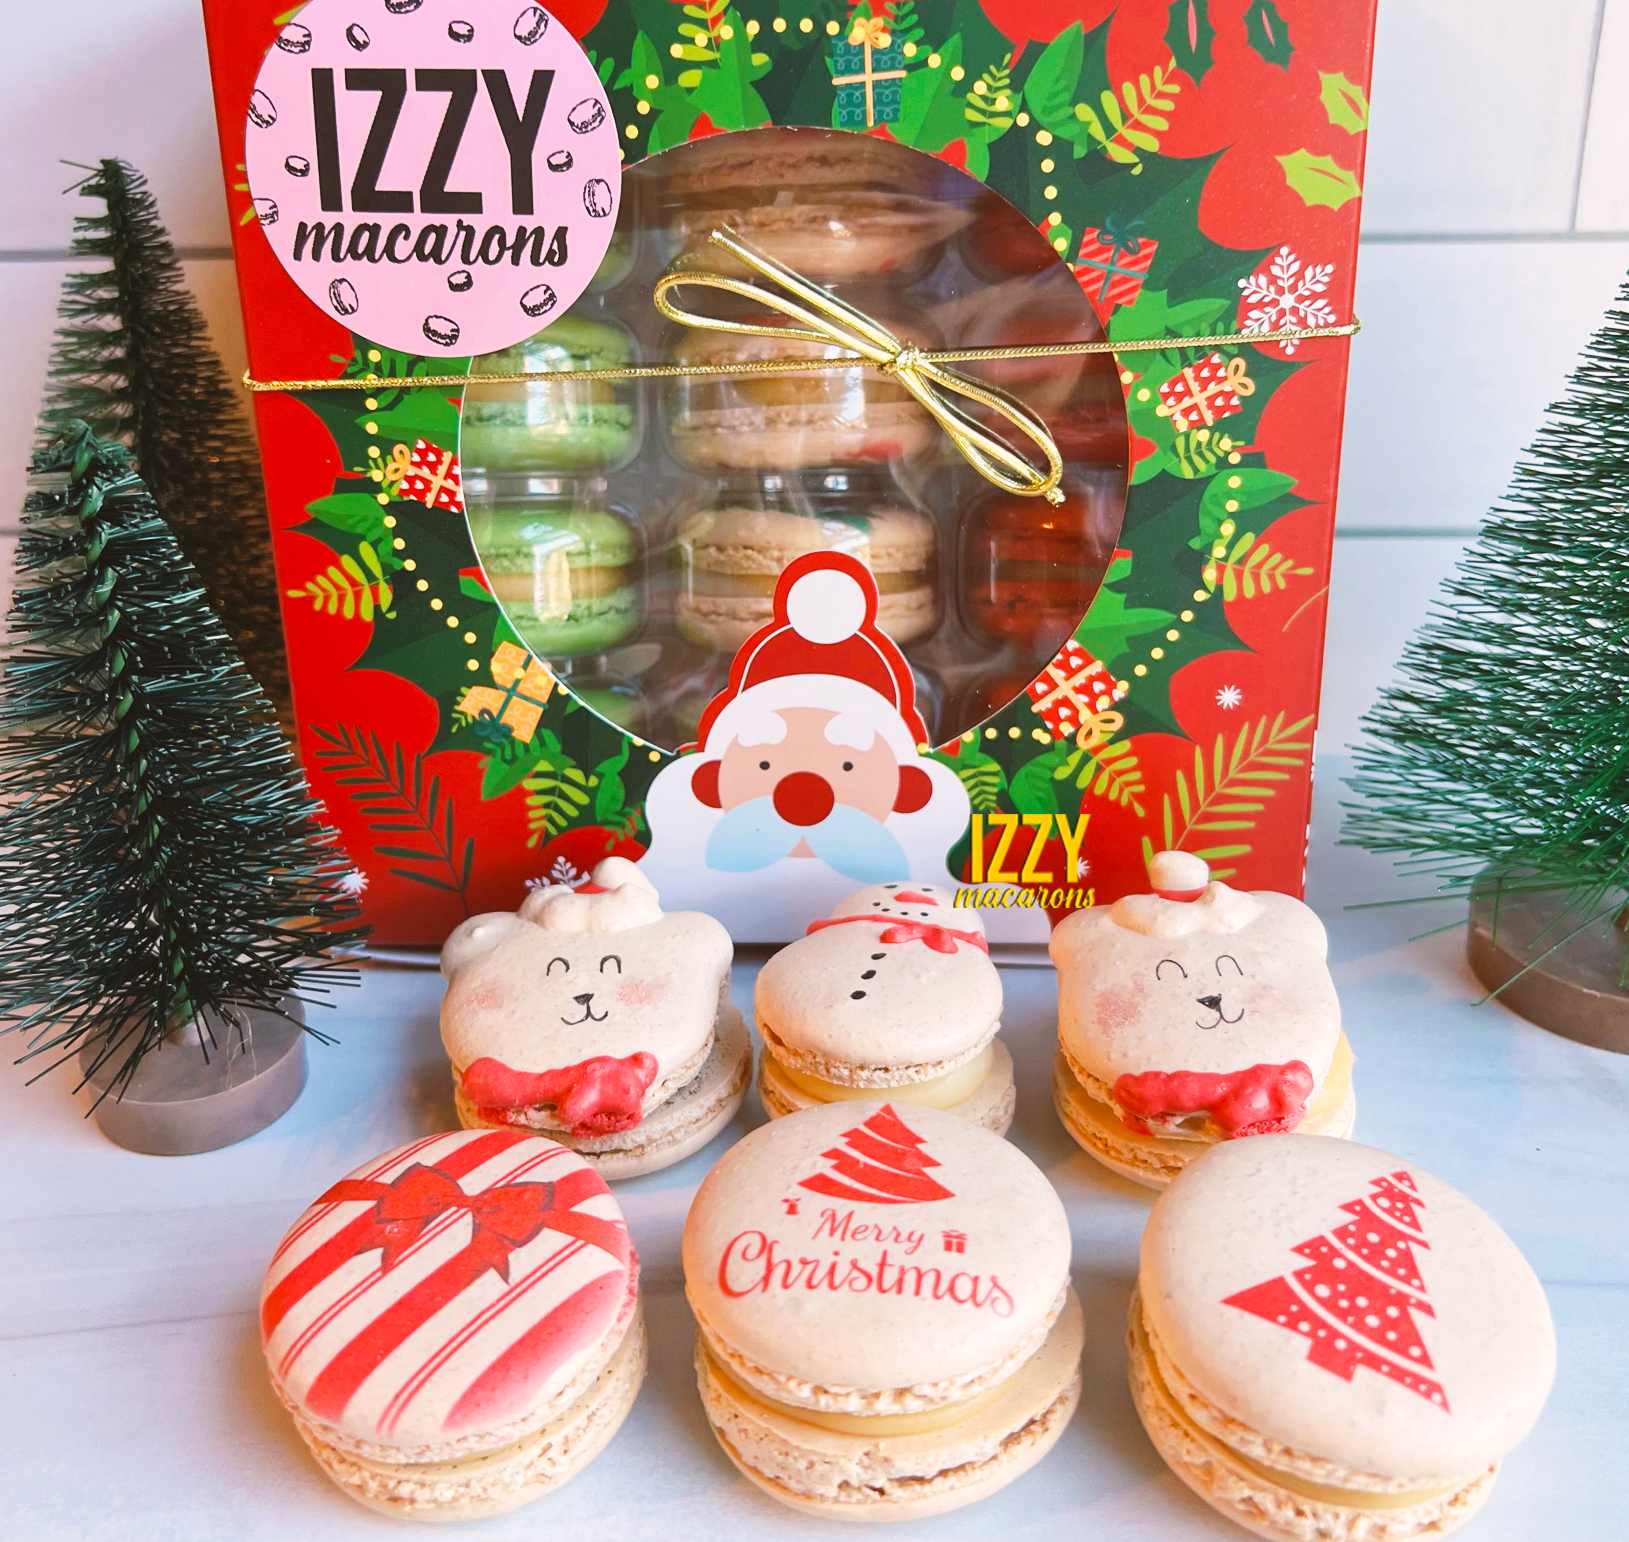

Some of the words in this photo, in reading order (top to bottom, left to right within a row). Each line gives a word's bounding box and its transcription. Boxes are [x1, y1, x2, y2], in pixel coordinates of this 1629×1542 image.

[311, 67, 555, 215] IZZY
[293, 218, 568, 267] macarons
[811, 1208, 925, 1255] Merry
[718, 1230, 1015, 1318] Christmas
